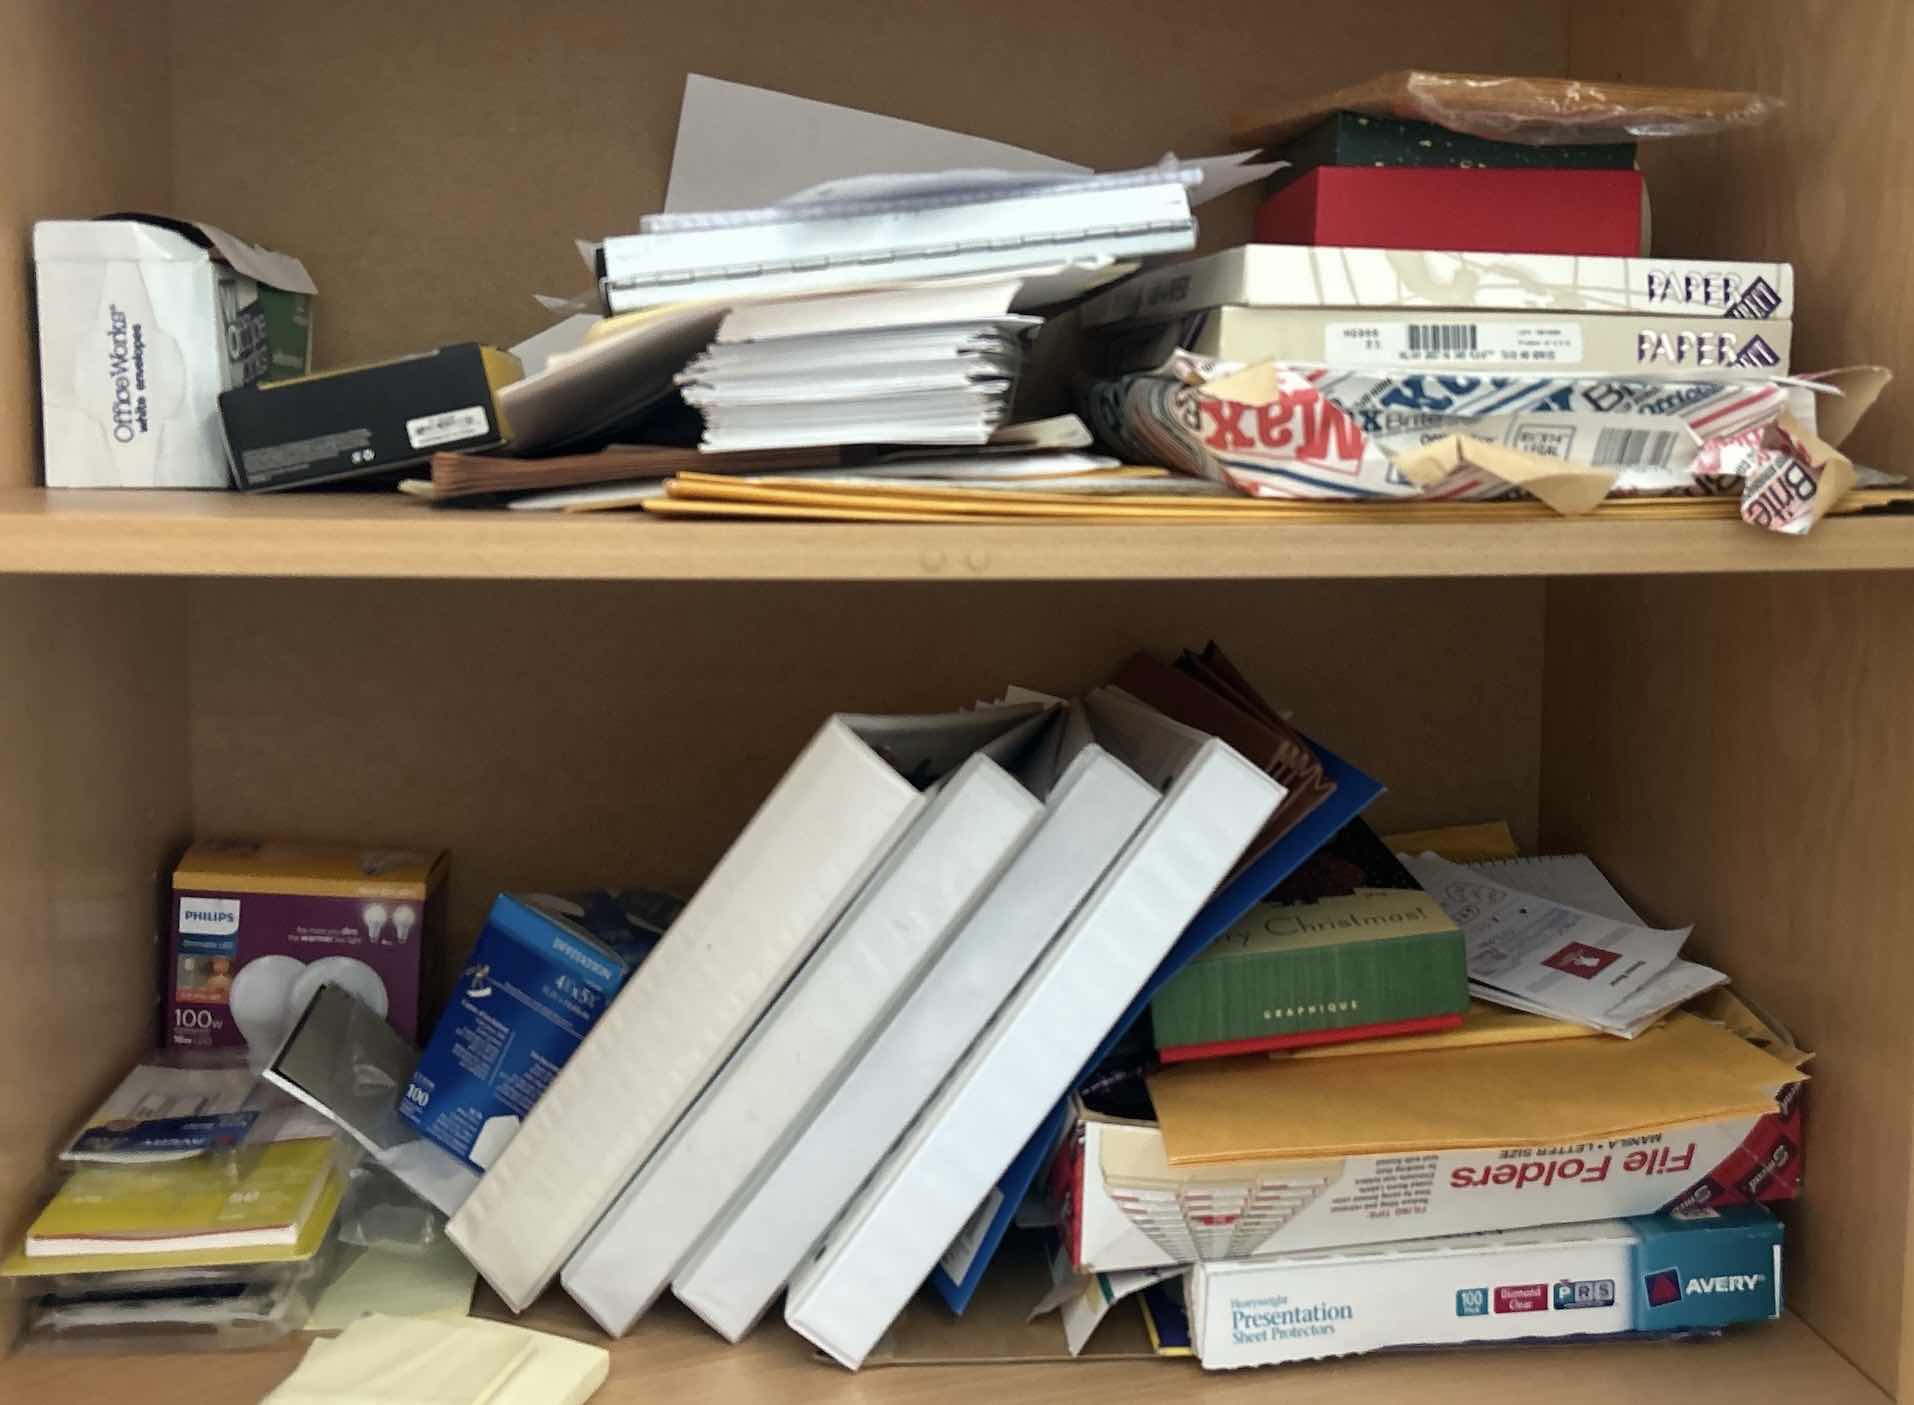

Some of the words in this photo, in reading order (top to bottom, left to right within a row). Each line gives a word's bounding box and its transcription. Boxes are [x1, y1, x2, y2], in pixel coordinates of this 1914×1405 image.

[1647, 270, 1742, 307] PAPER
[1637, 329, 1738, 367] PAPER
[1748, 459, 1820, 529] Brite
[184, 910, 234, 923] PHILIPS
[1500, 1147, 1533, 1160] SIZE
[1623, 1142, 1697, 1175] File
[1450, 1154, 1612, 1190] Folders
[1686, 1274, 1759, 1295] AVERY
[1231, 1301, 1354, 1330] Presentation
[1232, 1329, 1267, 1345] Sheet
[1271, 1323, 1336, 1342] Protectors
